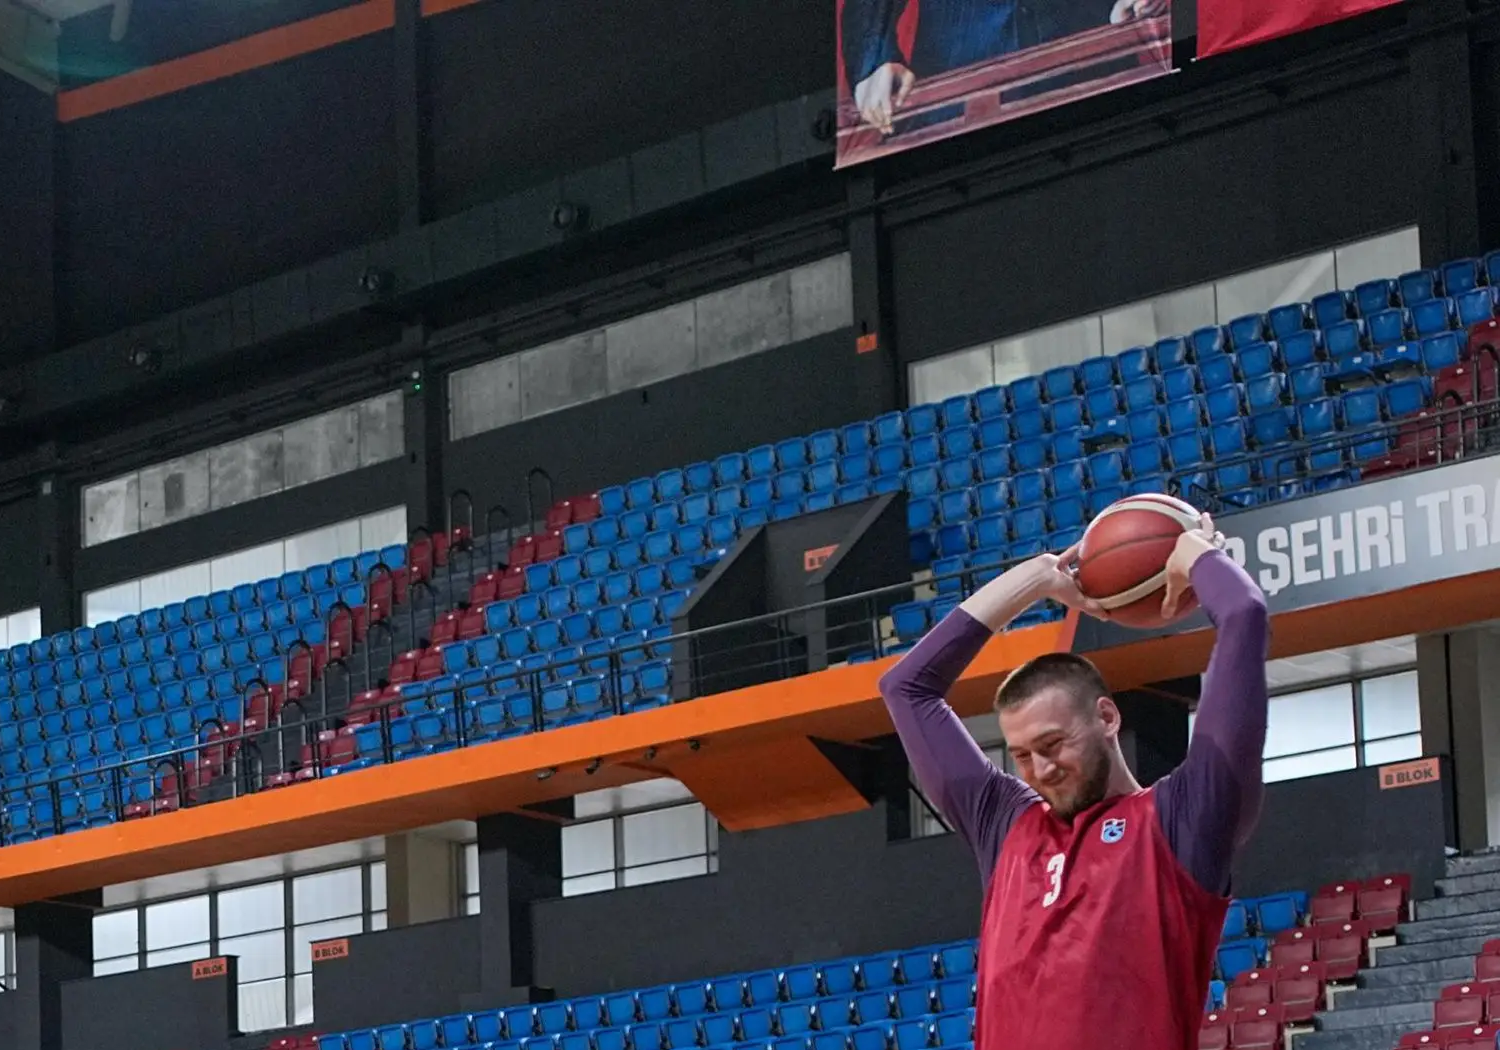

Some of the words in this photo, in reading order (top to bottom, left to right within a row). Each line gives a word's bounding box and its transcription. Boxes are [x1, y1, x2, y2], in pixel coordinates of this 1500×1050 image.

[1396, 767, 1433, 783] BLOK
[1042, 853, 1066, 908] 3
[321, 946, 344, 957] BLOK
[202, 963, 223, 975] BLOK
